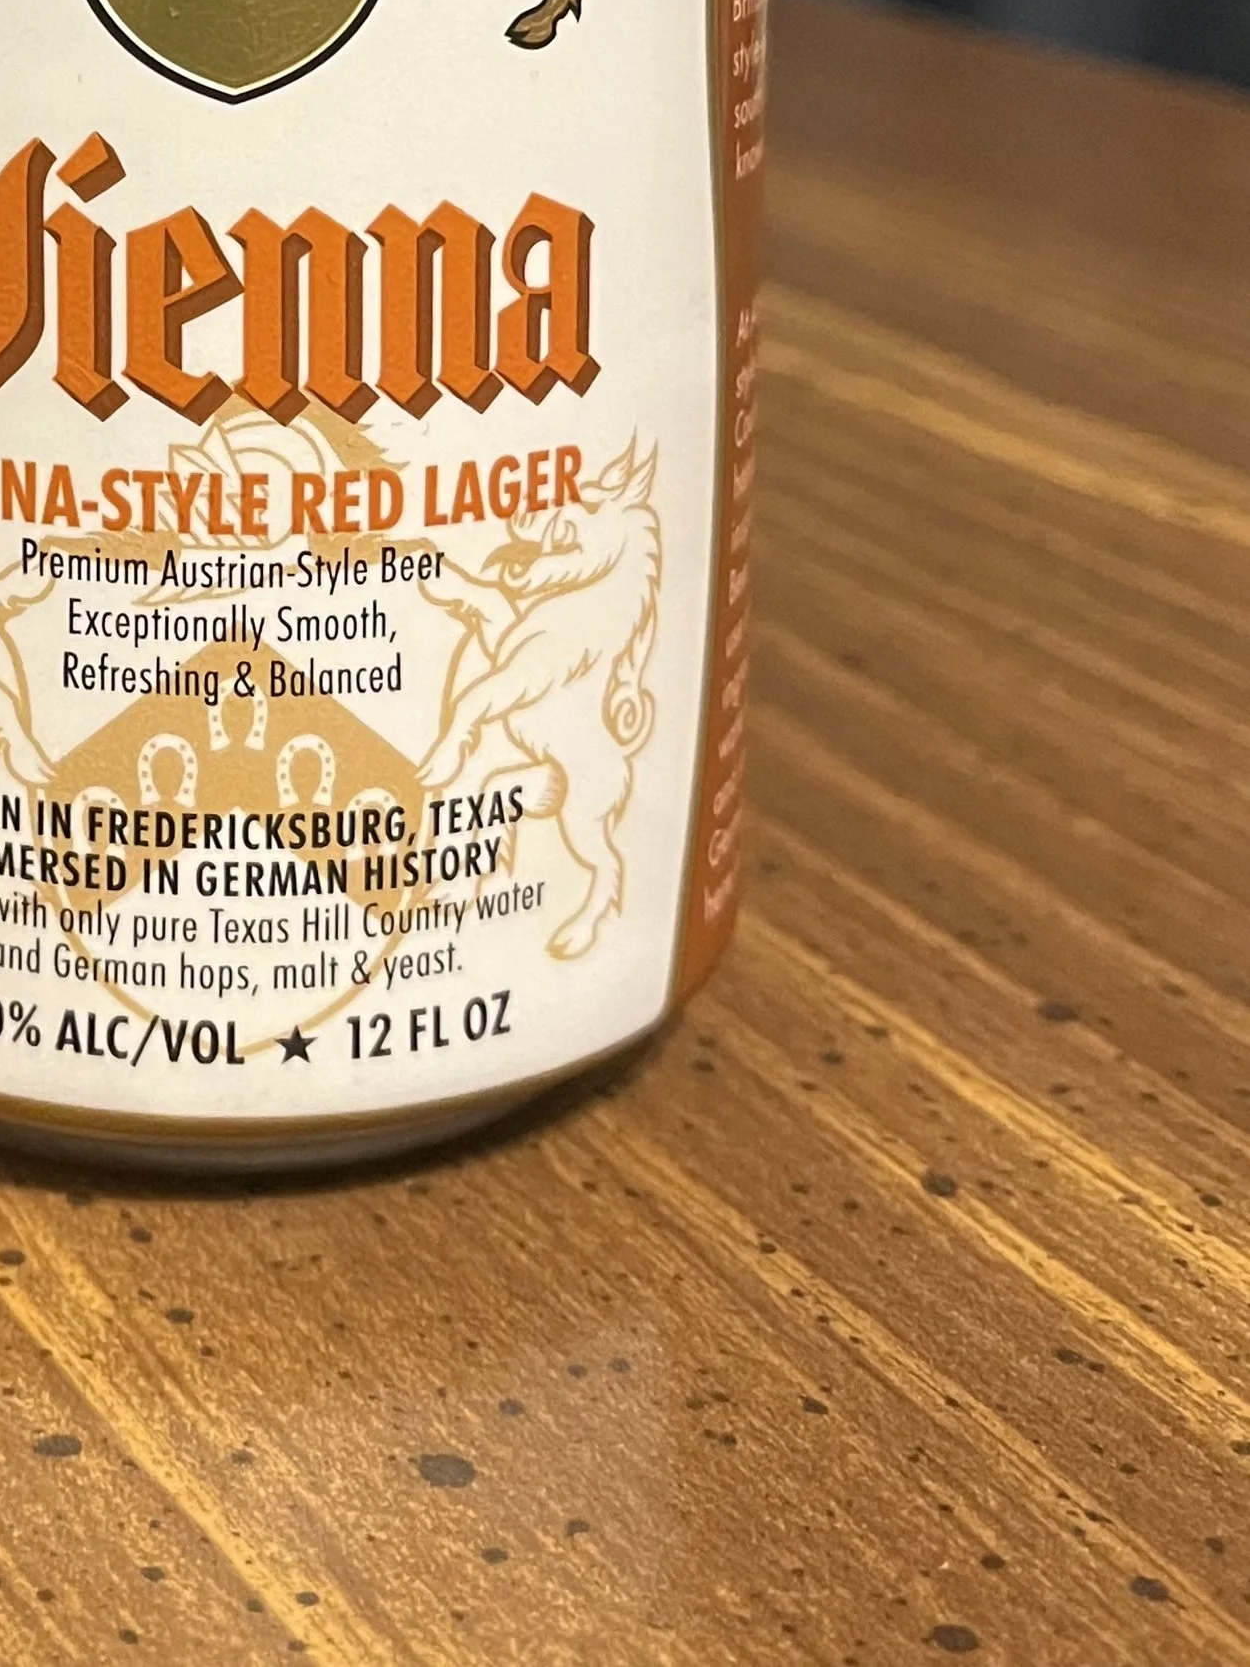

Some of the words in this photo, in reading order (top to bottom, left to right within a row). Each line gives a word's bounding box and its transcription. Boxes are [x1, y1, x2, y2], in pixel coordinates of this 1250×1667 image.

[291, 470, 403, 535] RED
[425, 443, 582, 526] LAGER
[22, 537, 148, 586] Premium
[160, 546, 368, 596] Austrian-Style
[381, 546, 445, 583] Beer
[68, 597, 265, 652] Exceptionally
[277, 599, 397, 643] Smooth,
[63, 651, 219, 707] Refreshing
[233, 660, 256, 698] &
[270, 652, 402, 698] Balanced
[37, 800, 72, 840] IN
[88, 805, 416, 850] FREDERICKSBURG,
[429, 786, 524, 837] TEXAS
[143, 858, 179, 896] IN
[196, 858, 348, 897] GERMAN
[364, 832, 501, 892] HISTORY
[59, 899, 120, 946] only
[133, 915, 197, 948] pure
[209, 908, 289, 944] Texas
[303, 903, 349, 943] Hill
[363, 899, 466, 938] Country
[476, 882, 544, 920] water
[54, 943, 166, 988] German
[180, 952, 258, 998] hops,
[273, 951, 338, 989] malt
[351, 950, 372, 986] &
[383, 943, 464, 990] yeast.
[55, 1010, 245, 1067] ALC/VOL
[347, 1014, 392, 1060] 12
[410, 1005, 449, 1052] FL
[464, 990, 511, 1041] OZ
